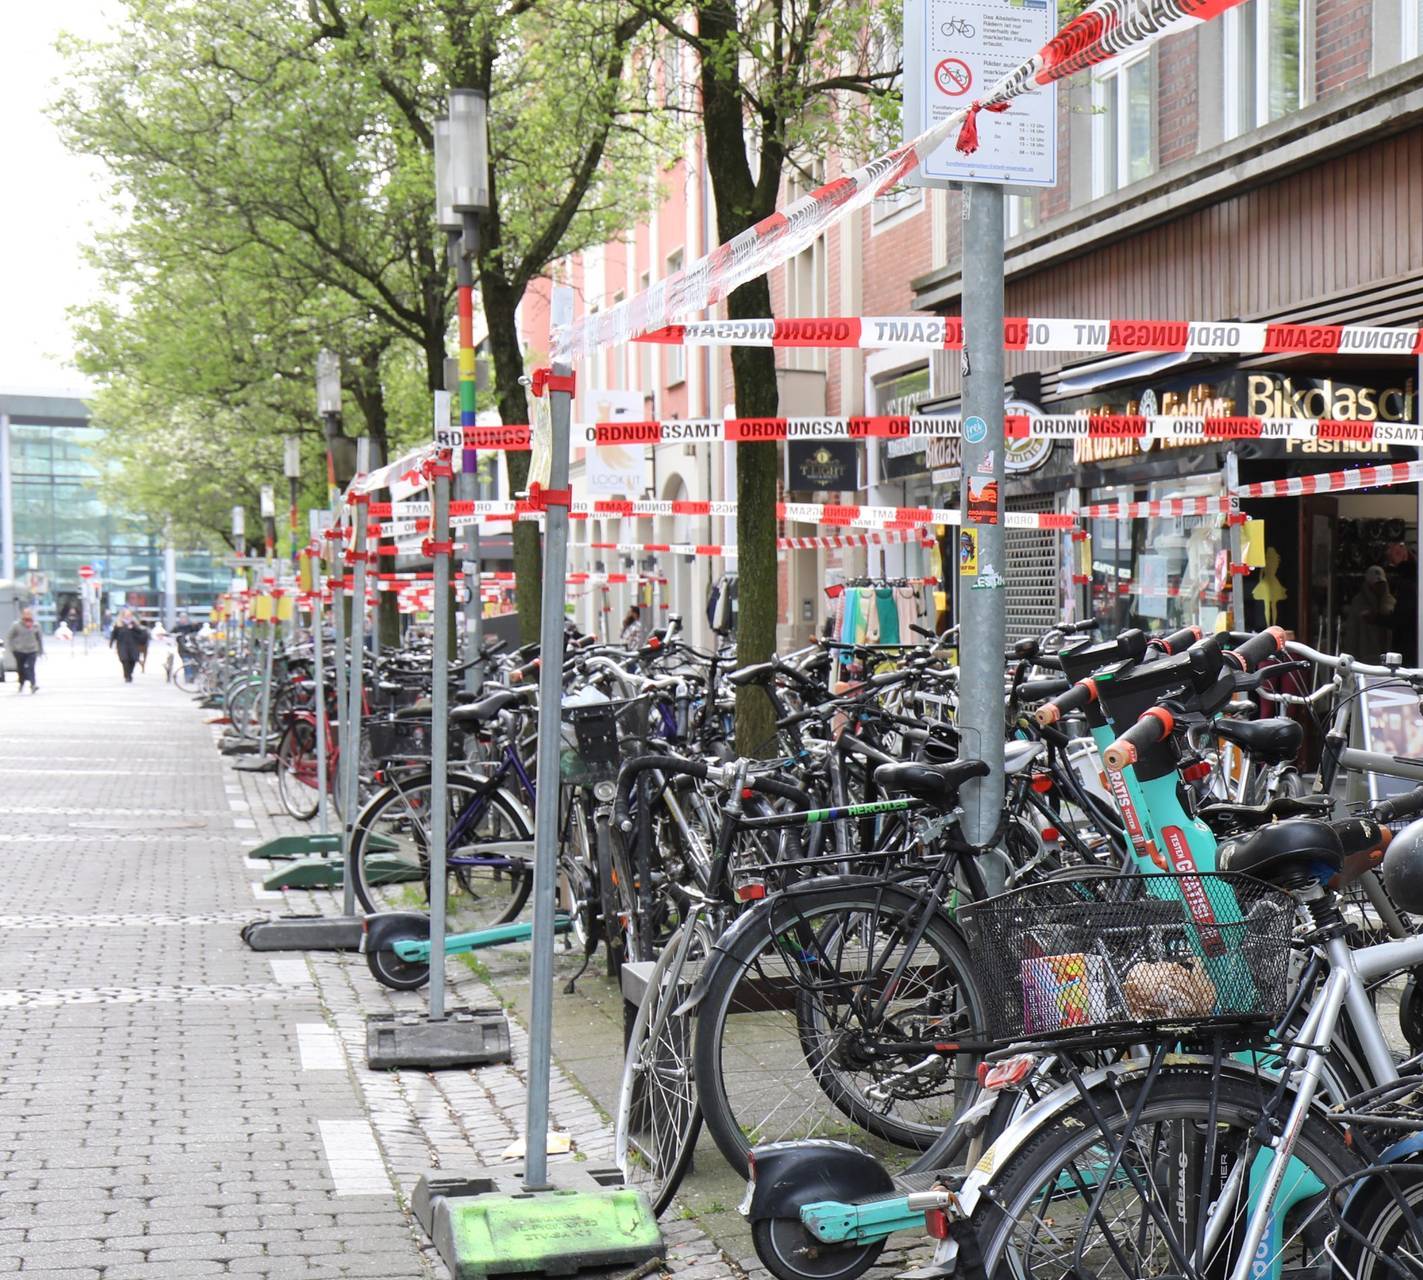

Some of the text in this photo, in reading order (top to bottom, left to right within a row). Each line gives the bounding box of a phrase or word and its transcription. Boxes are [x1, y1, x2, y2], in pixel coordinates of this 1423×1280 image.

[586, 422, 722, 443] ORDNUNGSAMT
[740, 420, 872, 438] ORDNUNGSAMT
[1032, 419, 1156, 437] ORDNUNGSAMT
[1173, 419, 1294, 437] ORDNUNGSAMT
[847, 801, 909, 816] HERCULES
